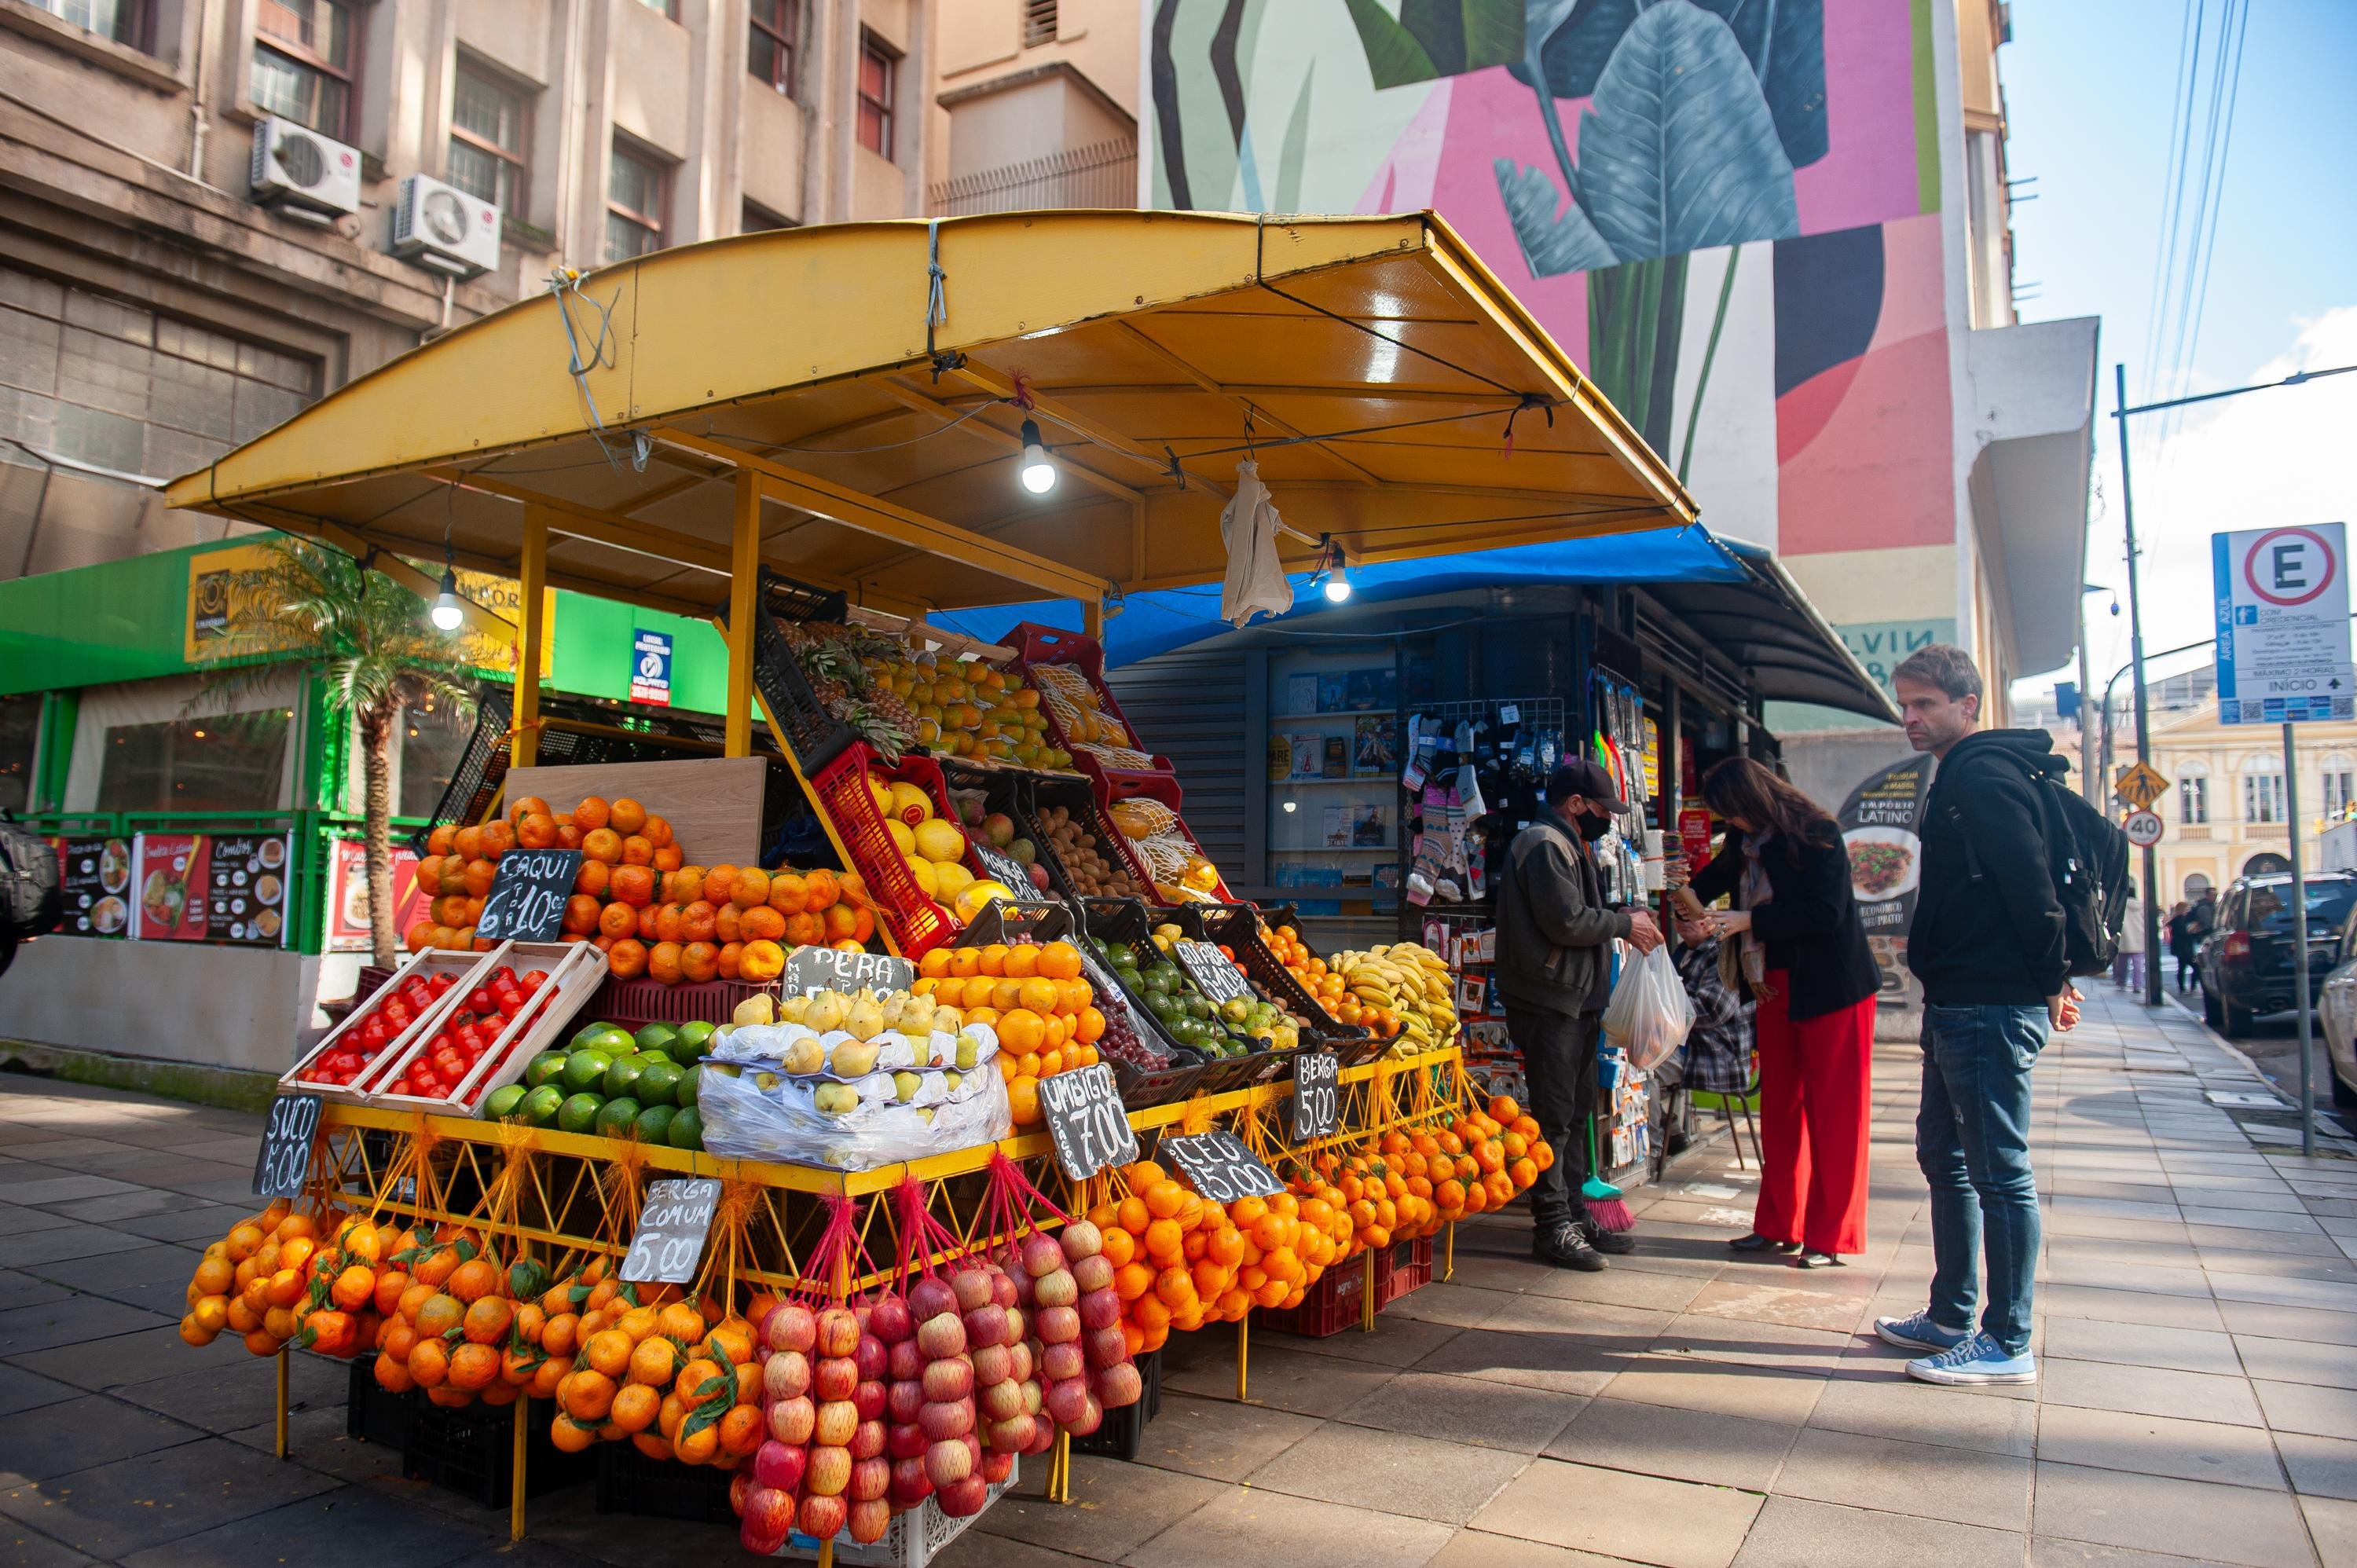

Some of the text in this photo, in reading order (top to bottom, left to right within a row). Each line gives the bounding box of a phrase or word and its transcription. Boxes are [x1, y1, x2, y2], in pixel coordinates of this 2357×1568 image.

[2273, 544, 2307, 589] E
[2254, 666, 2337, 677] MÁXIMO 2 HORAS
[2268, 678, 2318, 692] INÍCIO
[1859, 810, 1913, 824] LATINO
[2131, 819, 2158, 835] 40
[500, 854, 570, 881] CAQUI
[977, 846, 1028, 882] MANGA
[478, 888, 511, 933] 6
[813, 947, 895, 984] PERA
[1176, 943, 1230, 967] GOIABA
[1300, 1053, 1339, 1085] BERGA
[1043, 1064, 1112, 1114] UMBIGO
[267, 1097, 315, 1141] SUCO
[1299, 1086, 1336, 1138] 5,00
[1052, 1116, 1081, 1175] SACOLA
[261, 1141, 310, 1196] 5,00
[1196, 1163, 1273, 1200] 5,00
[640, 1202, 712, 1228] COMUM
[625, 1232, 693, 1283] 5,00
